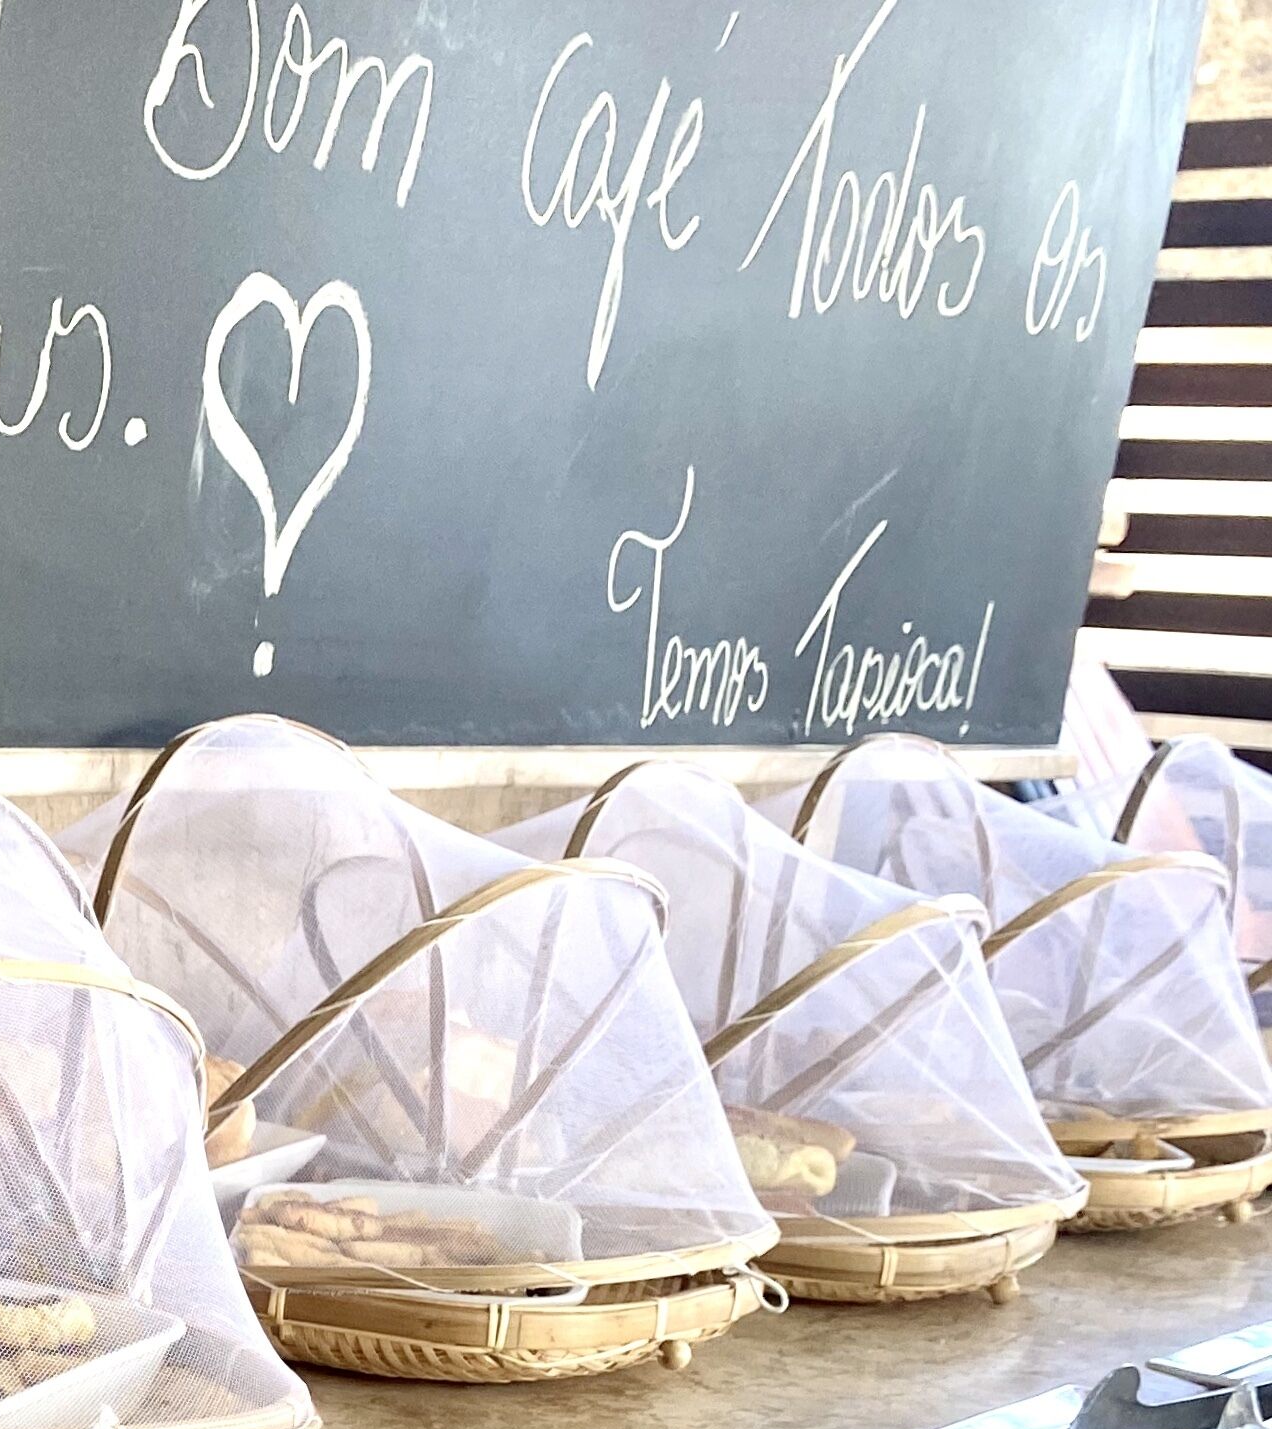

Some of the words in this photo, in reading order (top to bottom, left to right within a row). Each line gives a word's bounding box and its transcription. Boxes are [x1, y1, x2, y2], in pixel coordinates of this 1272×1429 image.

[522, 12, 739, 391] Café
[607, 466, 768, 730] Temos
[795, 520, 994, 737] Tapioca!
